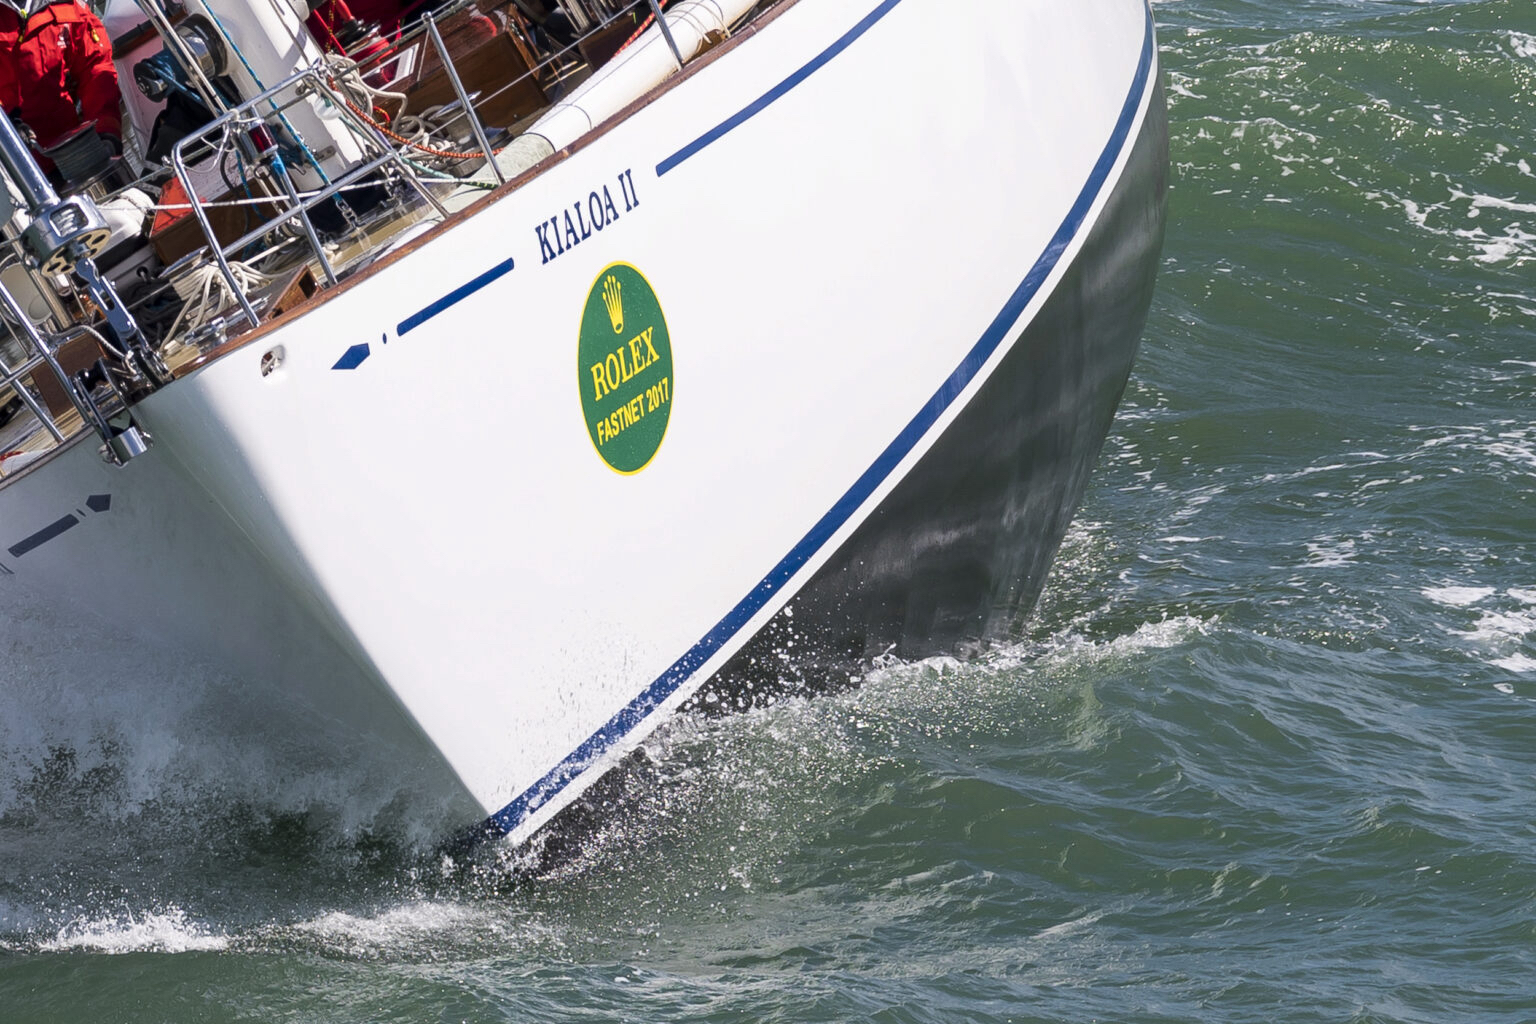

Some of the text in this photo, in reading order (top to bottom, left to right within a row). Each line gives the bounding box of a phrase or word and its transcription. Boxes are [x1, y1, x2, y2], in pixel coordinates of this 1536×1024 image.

[535, 168, 640, 265] KIALOA II
[590, 326, 660, 402] ROLEX
[596, 377, 669, 446] FASTNET 2017
